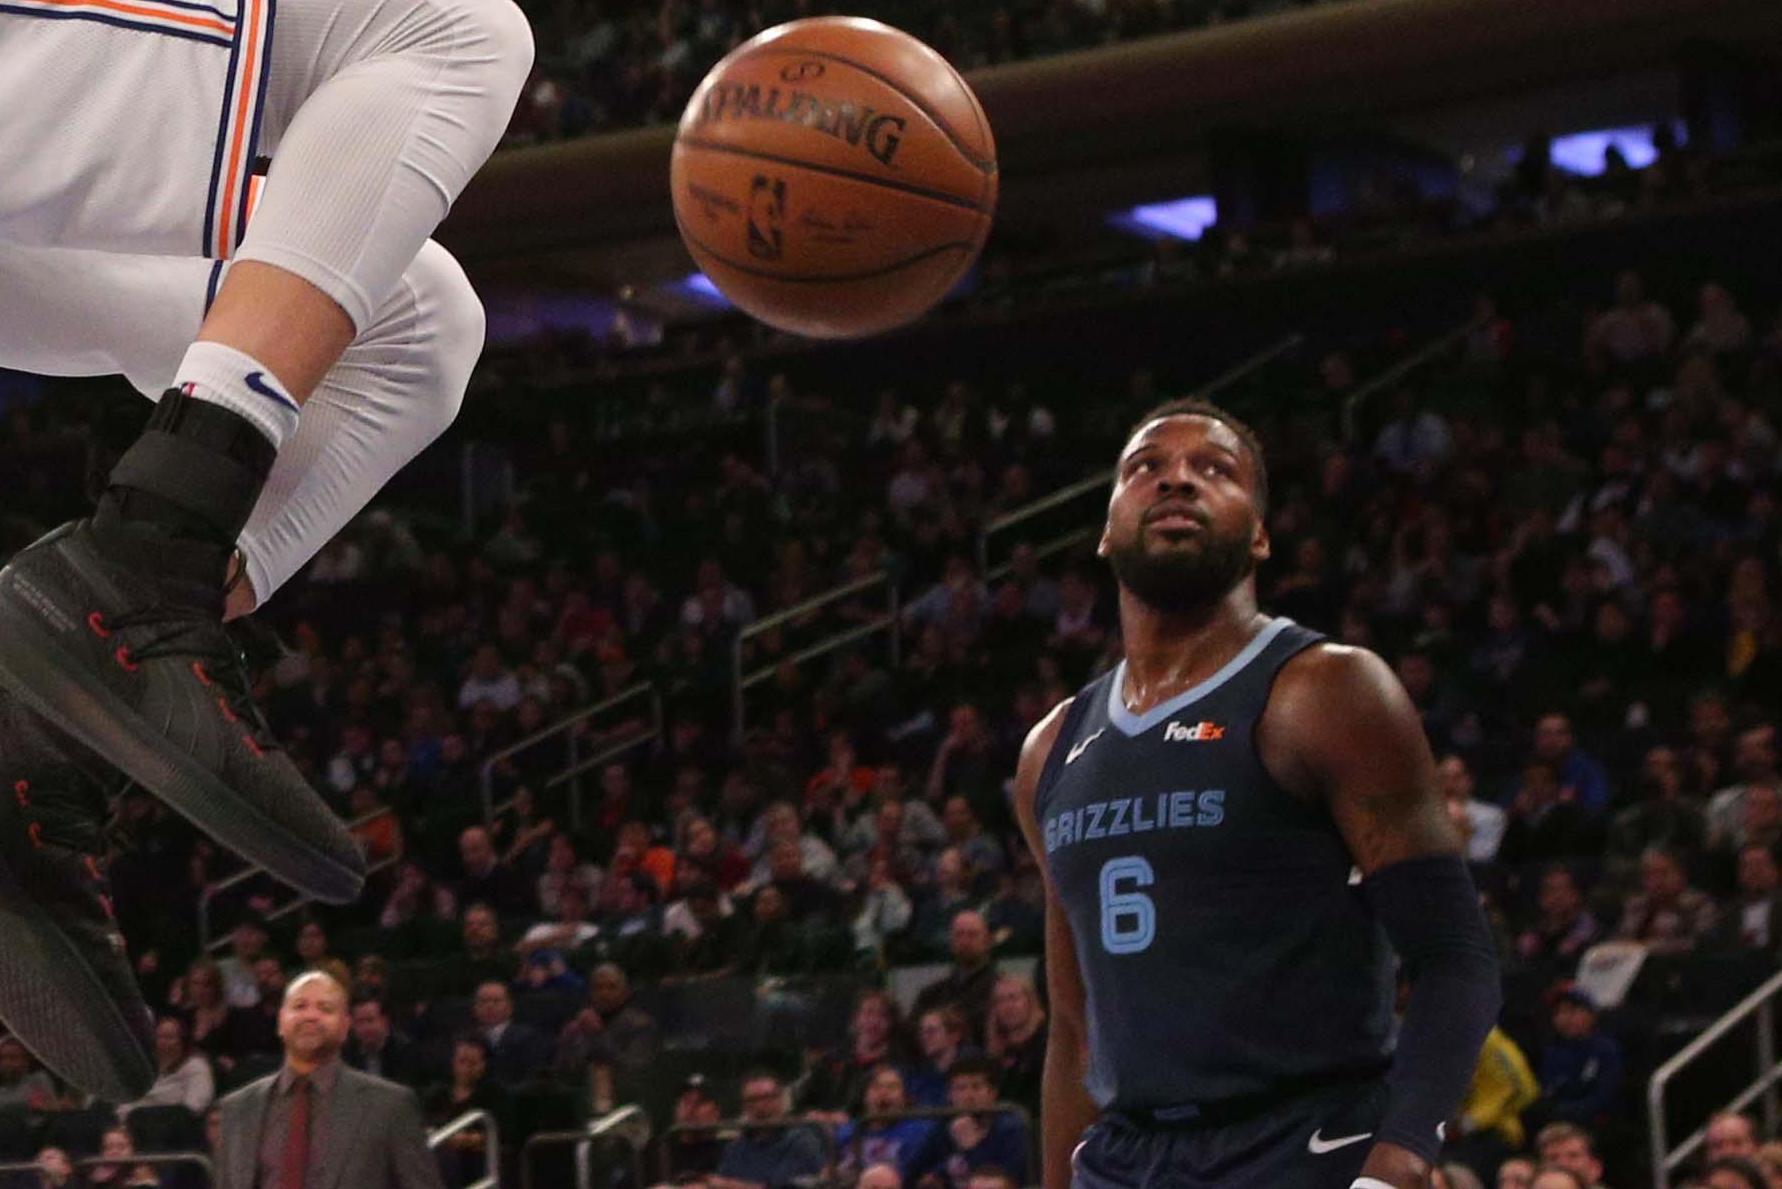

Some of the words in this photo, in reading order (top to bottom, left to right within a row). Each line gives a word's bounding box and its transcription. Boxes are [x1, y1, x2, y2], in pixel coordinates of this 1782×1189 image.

[1163, 720, 1226, 743] FedEx
[1043, 789, 1226, 854] GRIZZLIES
[1099, 855, 1156, 955] 6
